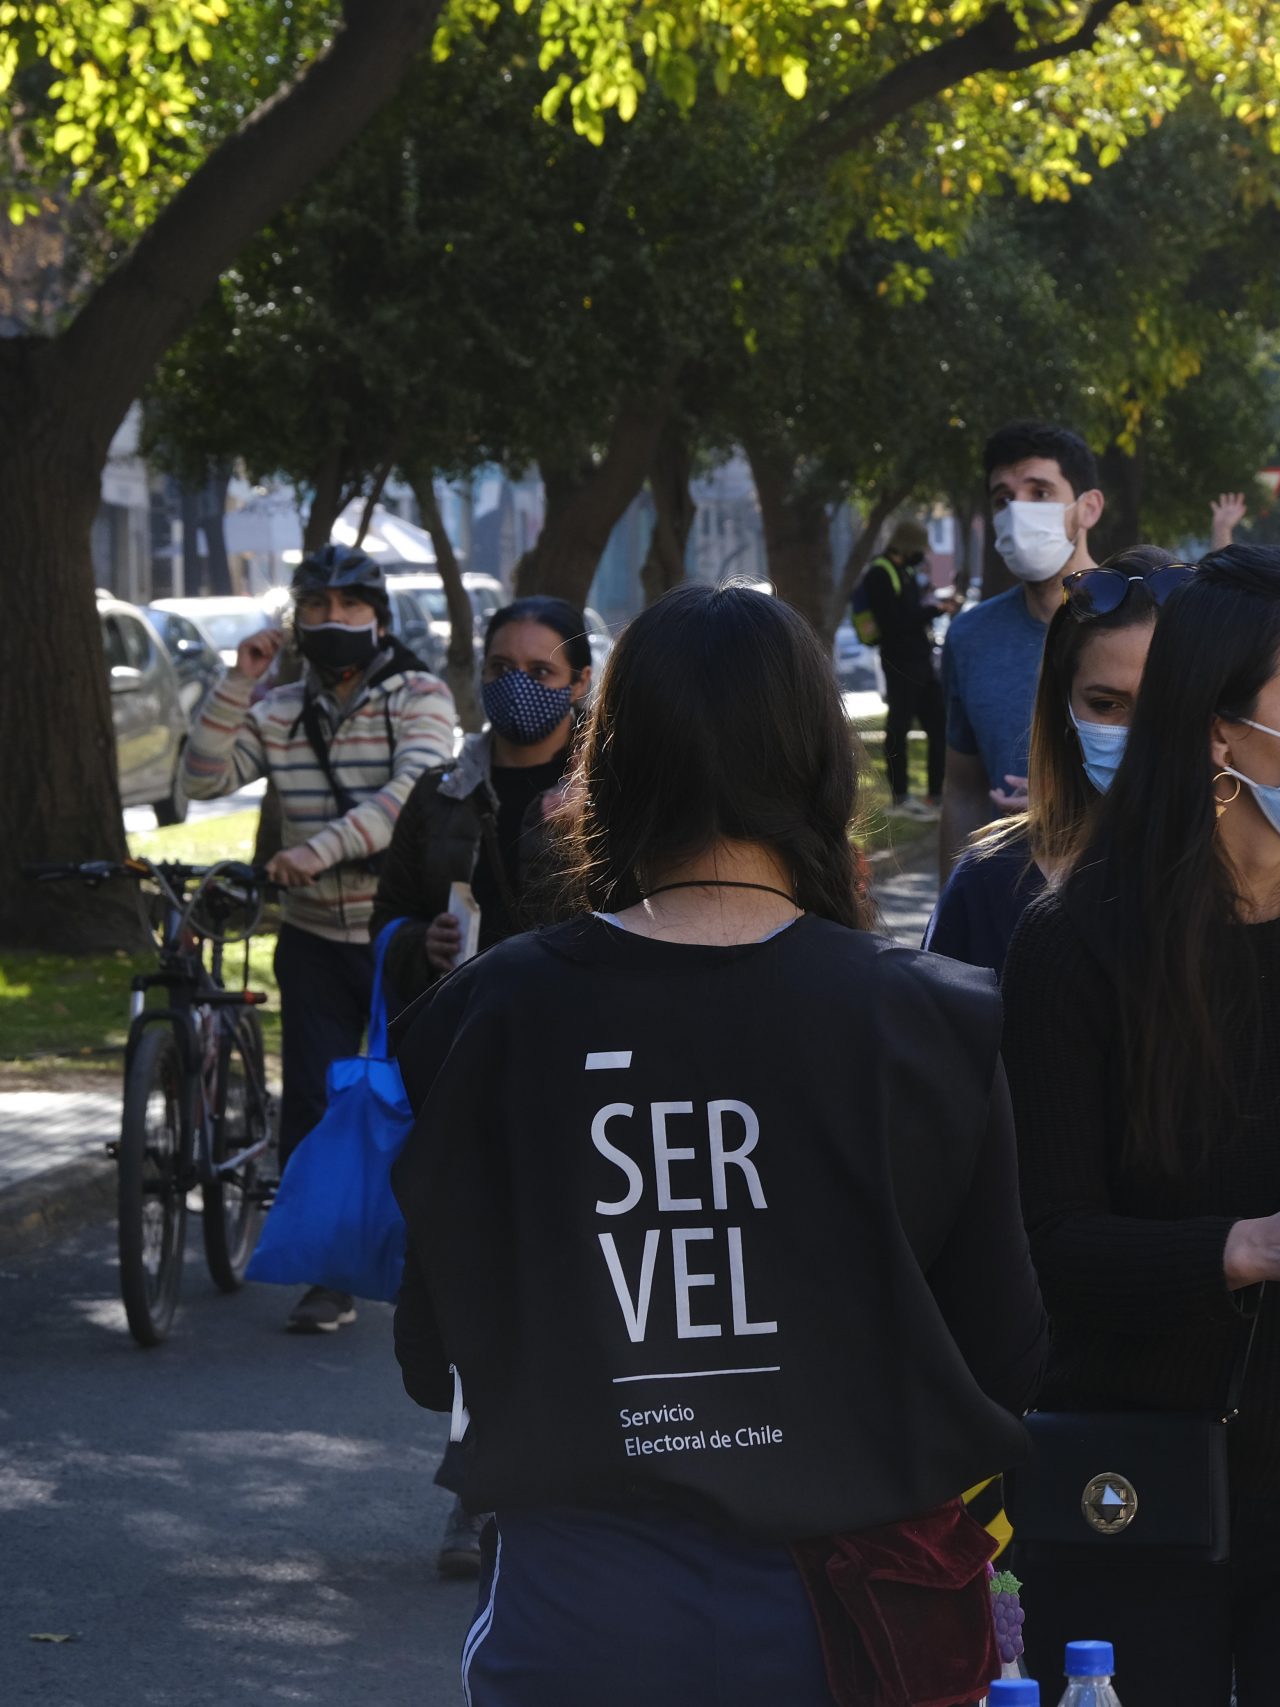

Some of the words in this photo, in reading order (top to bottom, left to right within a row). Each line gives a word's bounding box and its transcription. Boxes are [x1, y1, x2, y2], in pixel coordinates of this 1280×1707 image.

[590, 1099, 769, 1215] SER
[597, 1226, 778, 1343] VEL
[619, 1403, 695, 1428] Servicio
[624, 1430, 706, 1457] Electoral
[709, 1429, 732, 1449] de
[734, 1424, 783, 1447] Chile
